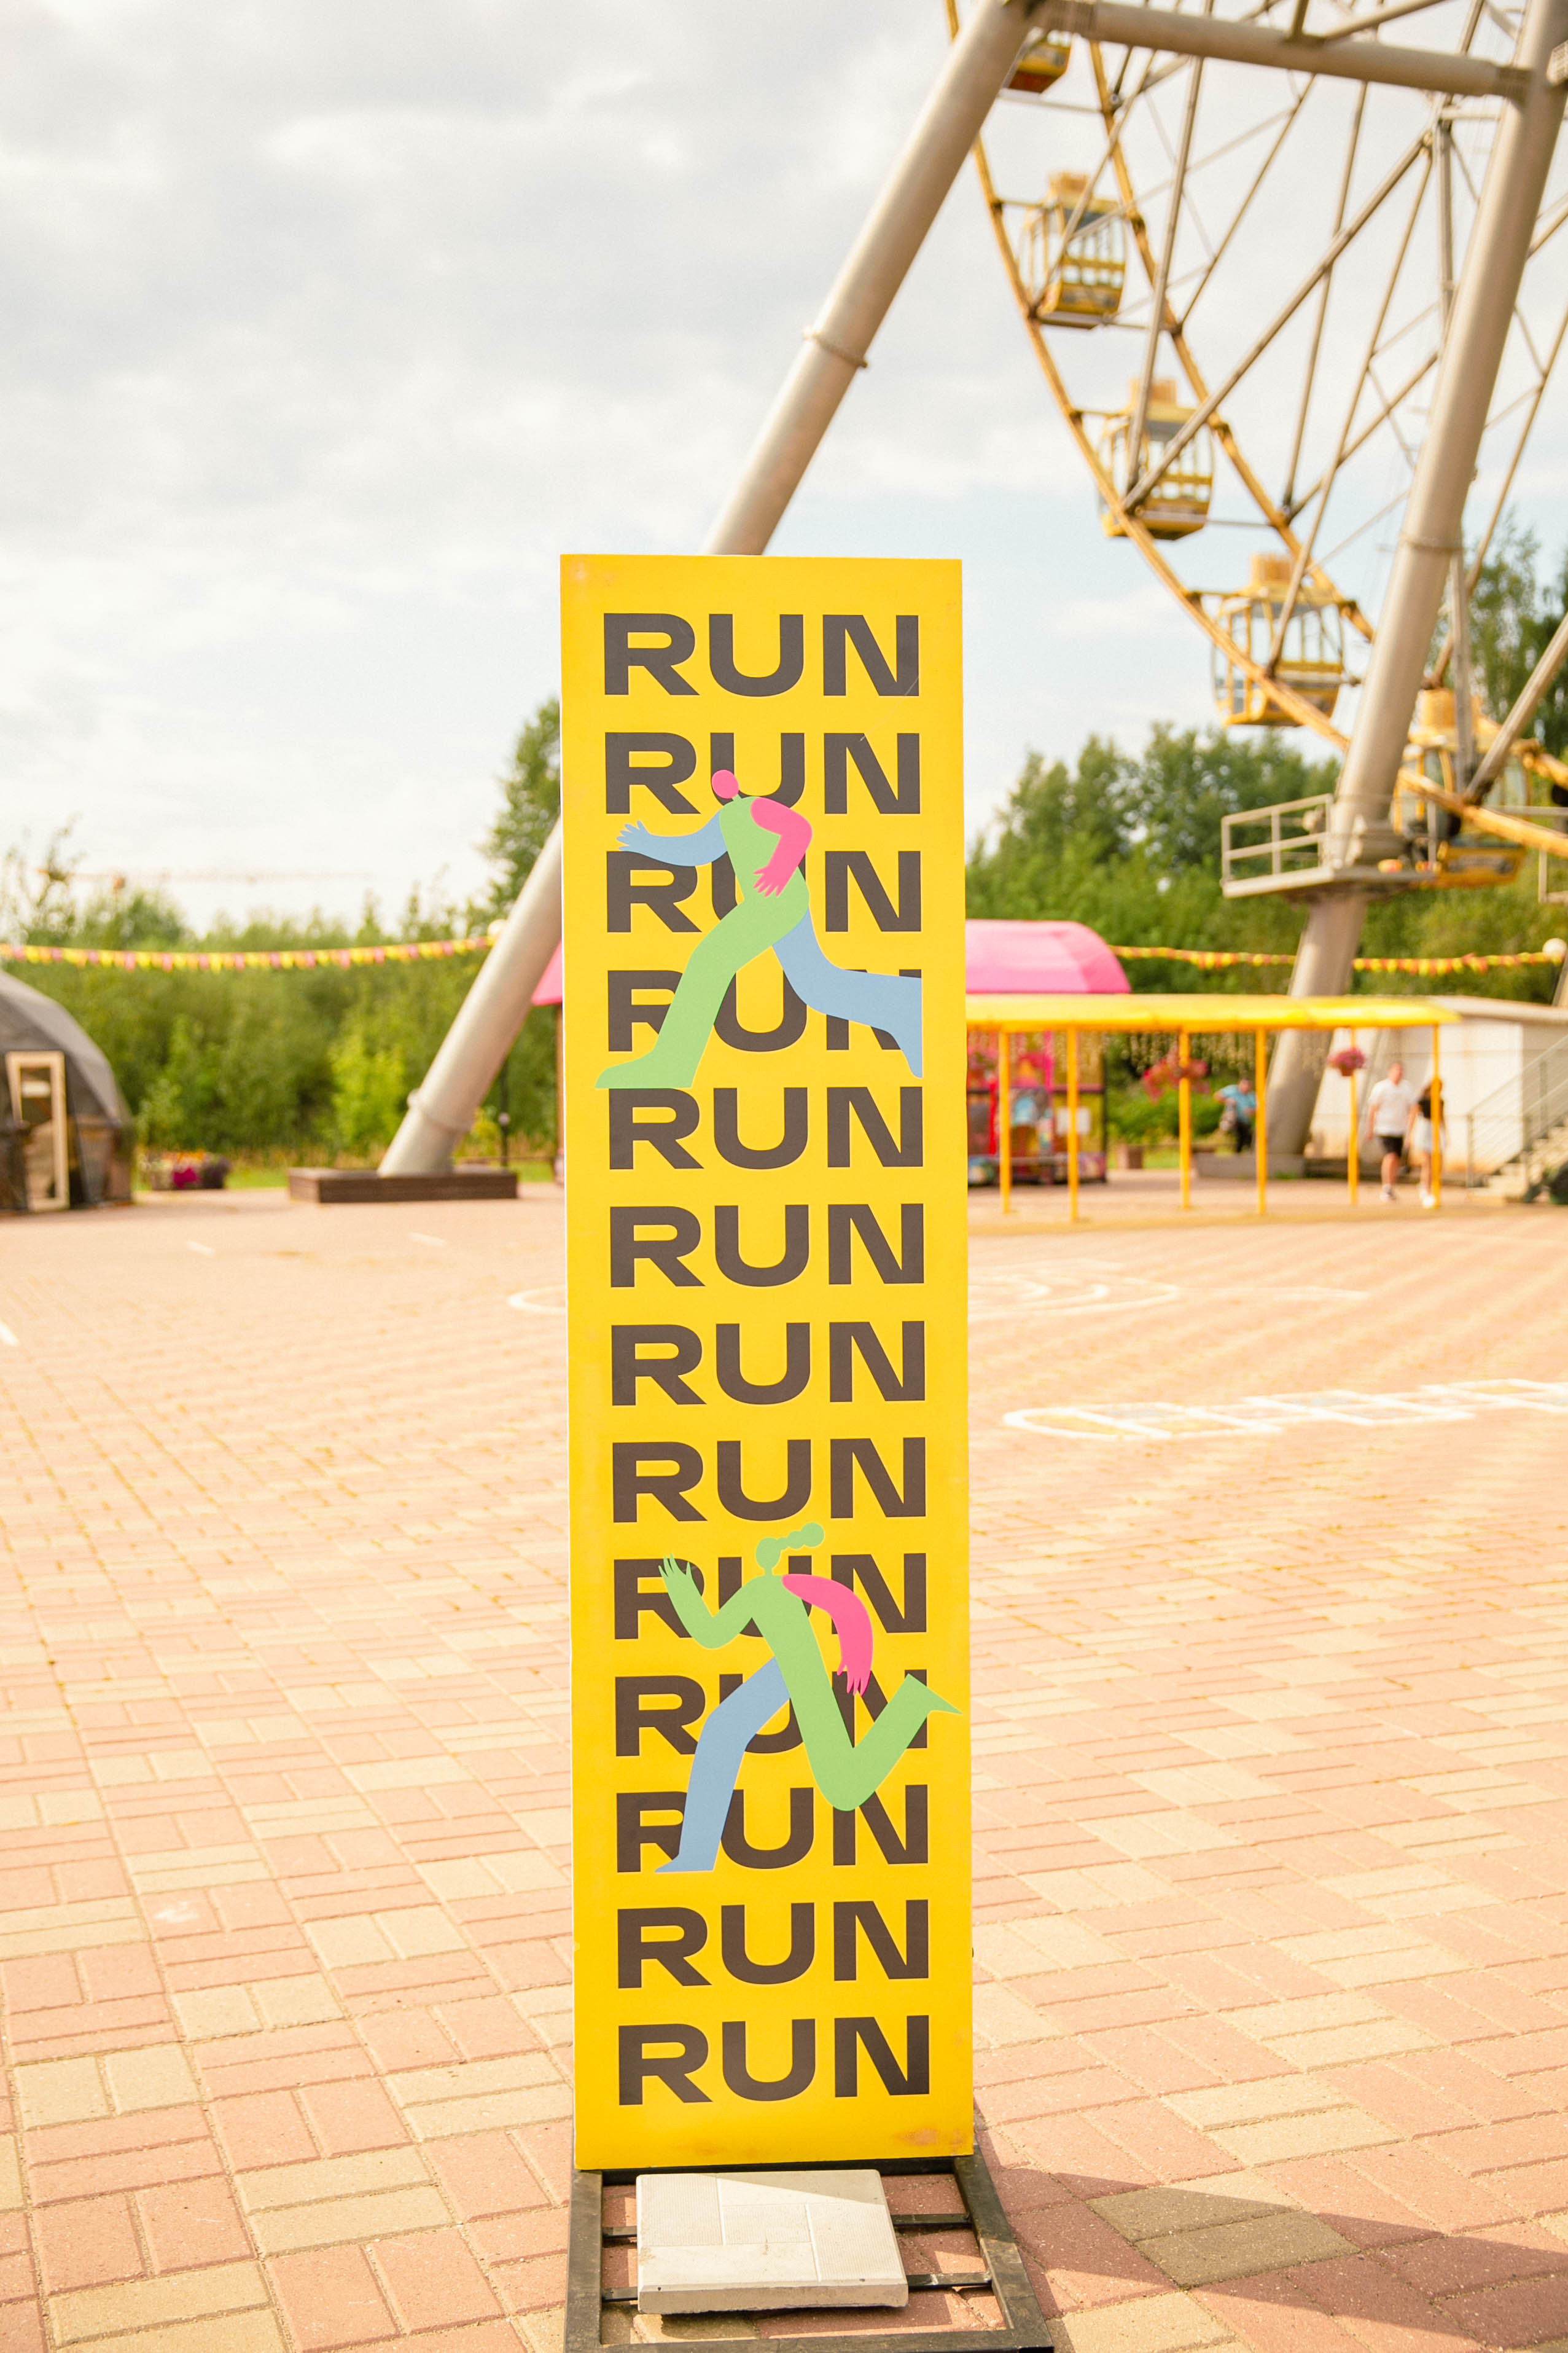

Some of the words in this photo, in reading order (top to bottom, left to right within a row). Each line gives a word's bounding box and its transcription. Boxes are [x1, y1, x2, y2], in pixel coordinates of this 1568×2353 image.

[604, 614, 919, 697] RUN
[606, 732, 920, 814] RUN
[608, 969, 921, 1052] RU
[609, 1087, 922, 1170] RUN
[610, 1204, 924, 1287] RUN
[612, 1321, 924, 1405] RUN
[613, 1438, 926, 1522] RUN
[617, 1785, 927, 1872] RUN
[618, 1900, 928, 1988] RUN
[619, 2015, 929, 2105] RUN
